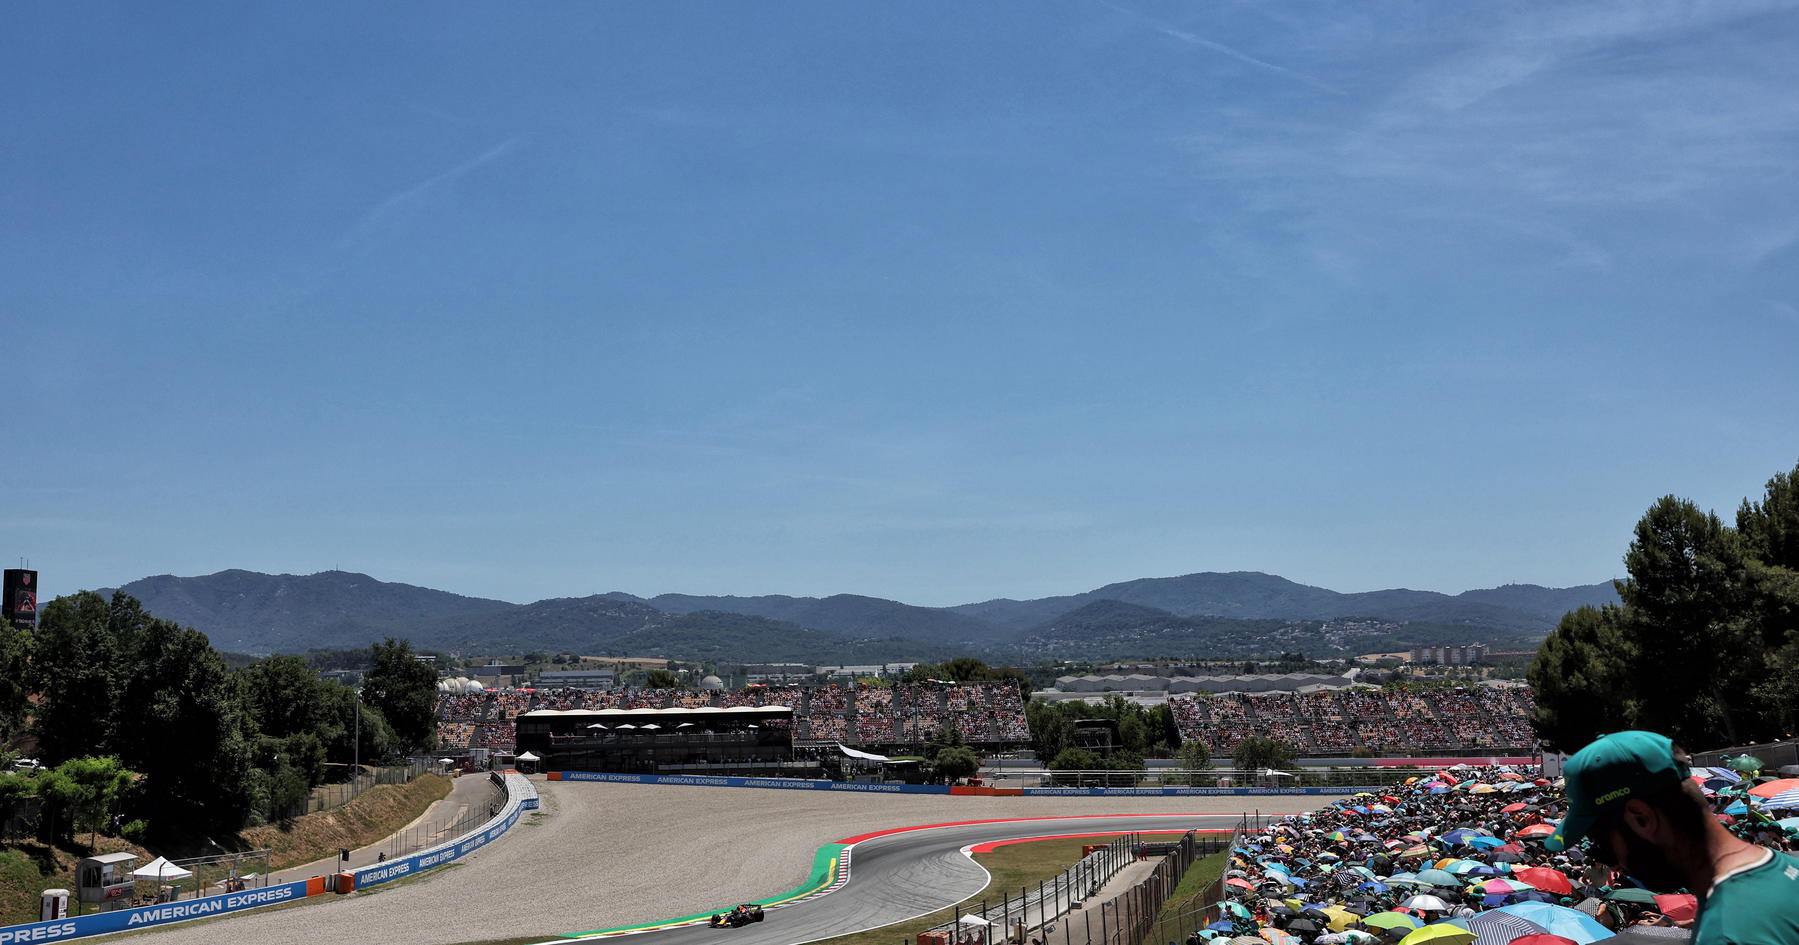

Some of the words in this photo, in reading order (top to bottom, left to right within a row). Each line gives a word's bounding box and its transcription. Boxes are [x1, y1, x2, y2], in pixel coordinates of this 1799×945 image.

[1595, 787, 1630, 805] aramco
[360, 869, 388, 885] AMERICAN
[388, 862, 410, 877] EXPRESS
[127, 900, 222, 926] AMERICAN
[227, 887, 292, 909] EXPRESS
[0, 922, 76, 945] PRESS
